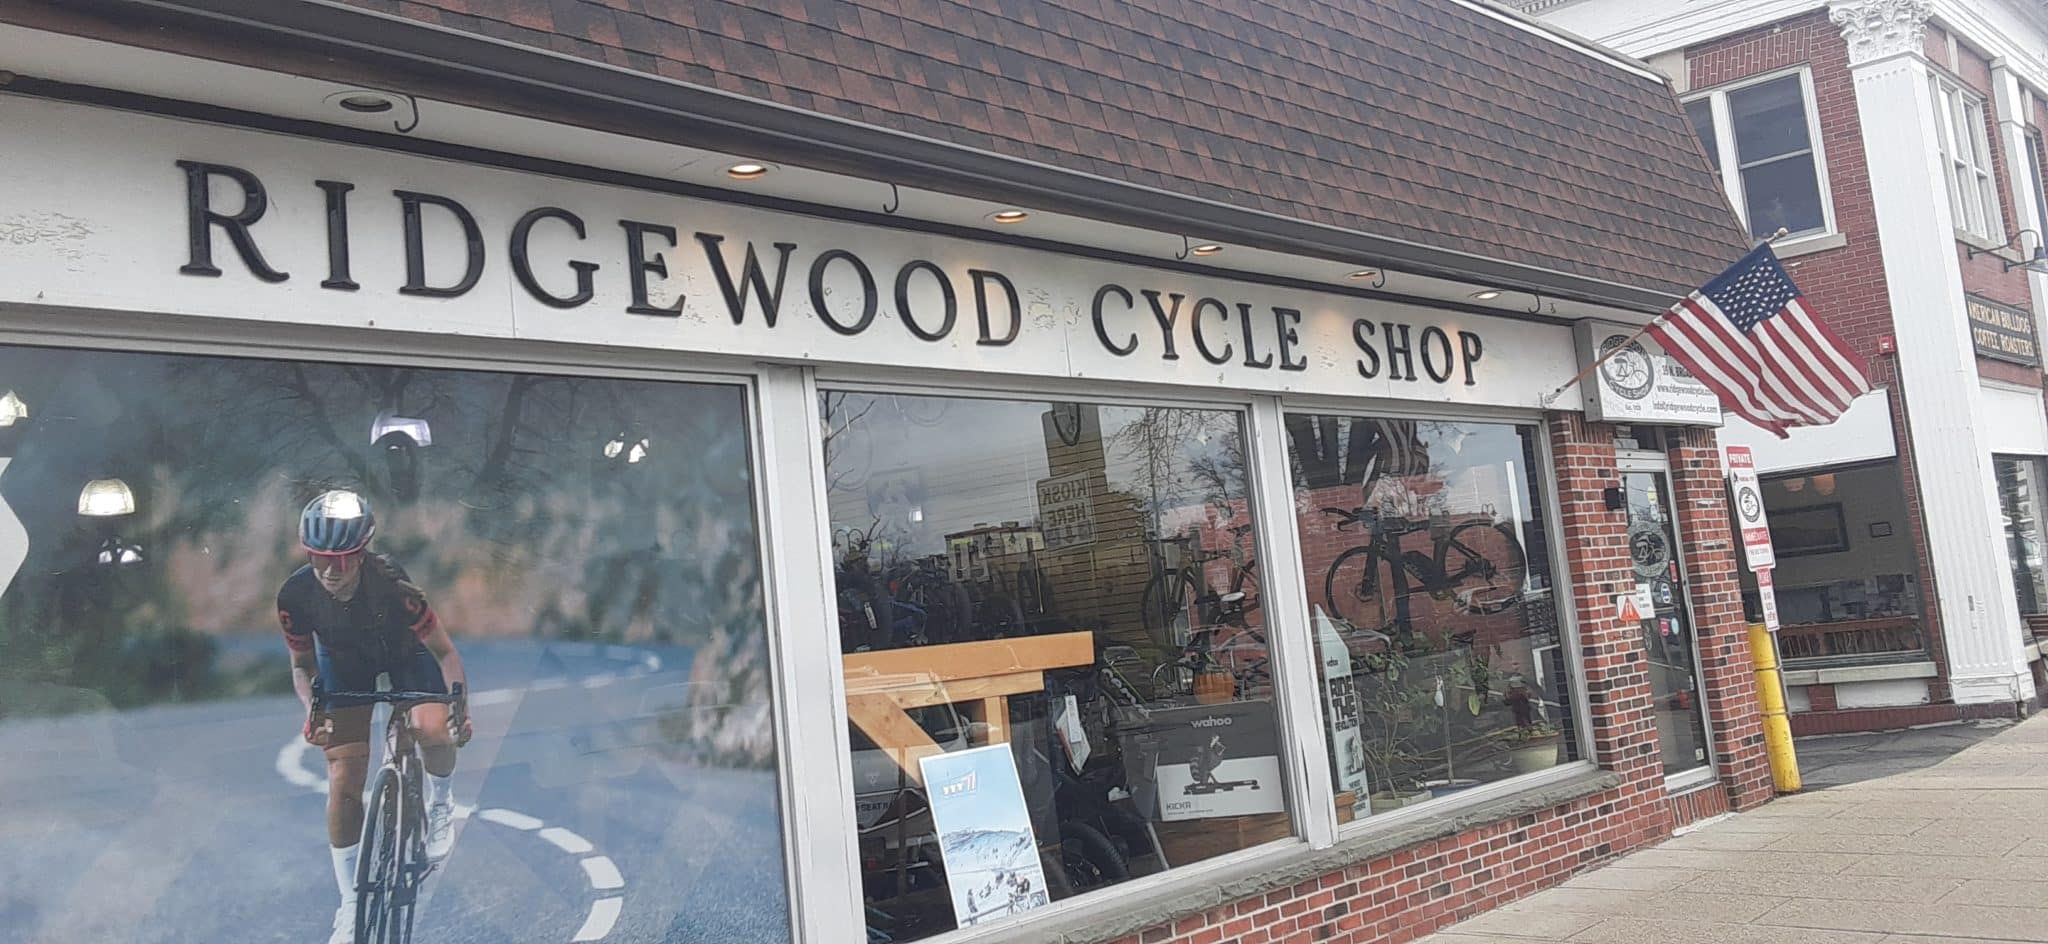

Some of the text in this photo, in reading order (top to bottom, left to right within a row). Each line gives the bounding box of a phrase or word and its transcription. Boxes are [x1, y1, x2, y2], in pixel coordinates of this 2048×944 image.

[176, 159, 1483, 386] RIDGEWOOD CYCLE SHOP
[1967, 301, 2031, 335] AMERICAN BULLDOG
[1973, 327, 2034, 357] COFFEE ROASTERS
[1329, 674, 1353, 697] RIDE
[1332, 697, 1358, 721] THE
[1191, 716, 1232, 728] wahoo
[1166, 801, 1191, 811] KICKR
